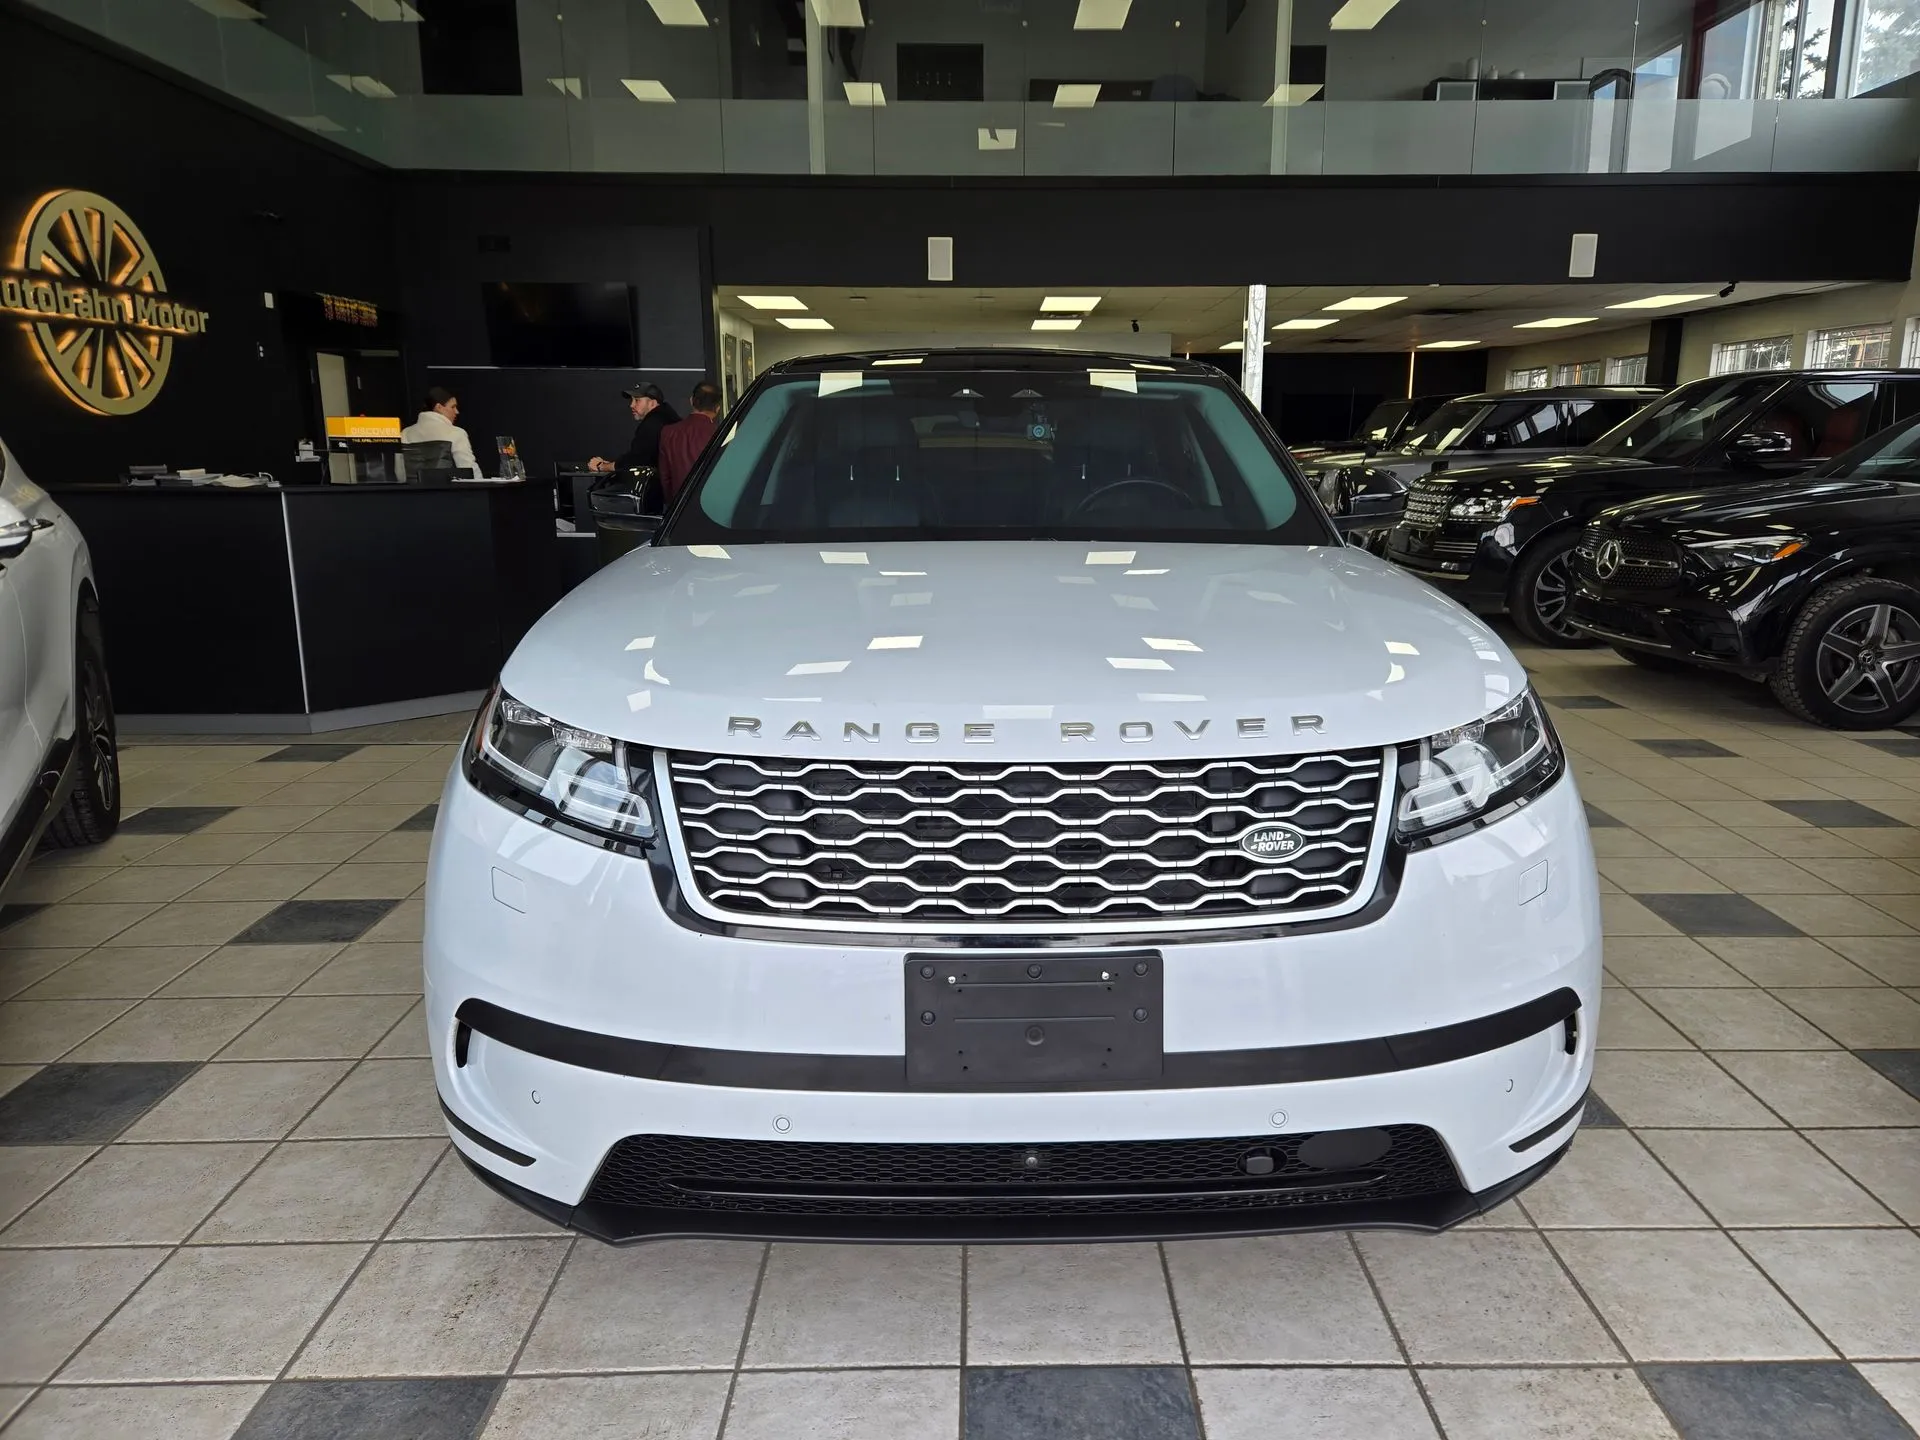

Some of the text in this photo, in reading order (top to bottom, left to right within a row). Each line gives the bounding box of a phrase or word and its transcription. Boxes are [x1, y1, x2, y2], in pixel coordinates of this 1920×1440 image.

[0, 278, 209, 333] utobahn Motor
[351, 427, 398, 436] DISCOVER
[728, 714, 1327, 744] RANGE ROVER
[1253, 831, 1284, 843] LAND
[1257, 840, 1295, 852] ROVER
